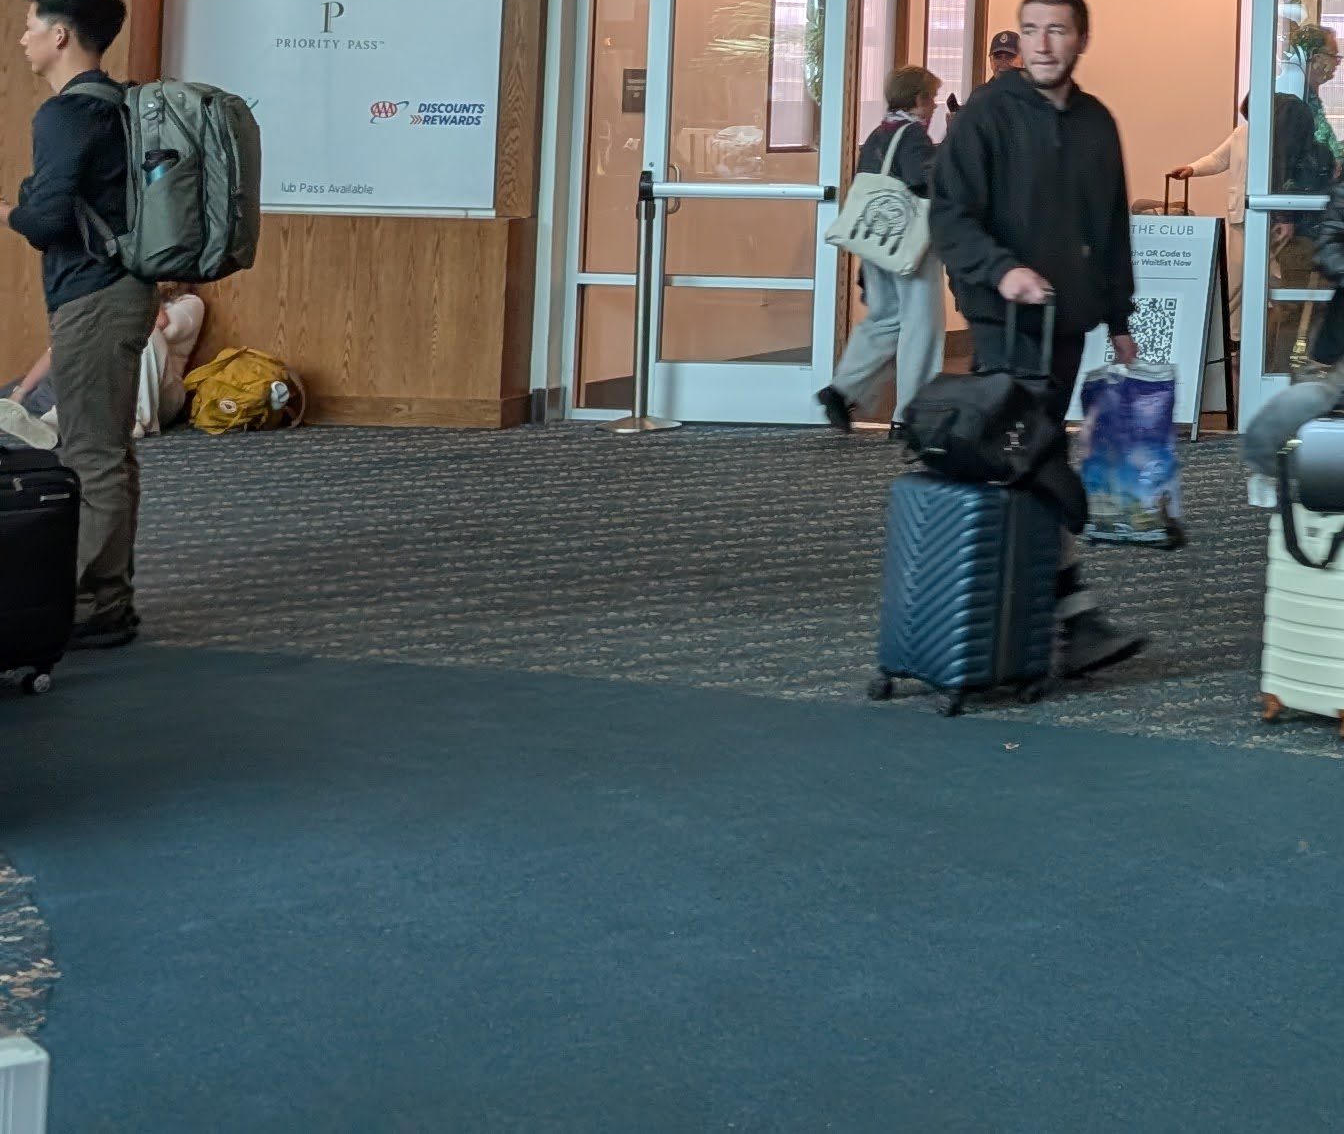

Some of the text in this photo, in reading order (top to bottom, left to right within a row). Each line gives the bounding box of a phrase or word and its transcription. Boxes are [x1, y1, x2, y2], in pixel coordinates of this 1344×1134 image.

[275, 38, 340, 50] PRIORITY
[372, 102, 397, 117] AAA
[418, 103, 485, 114] DISCOUNTS
[422, 115, 482, 126] REWARDS
[300, 183, 325, 194] Pass
[328, 184, 374, 194] Available
[1131, 224, 1194, 235] THE CLUB
